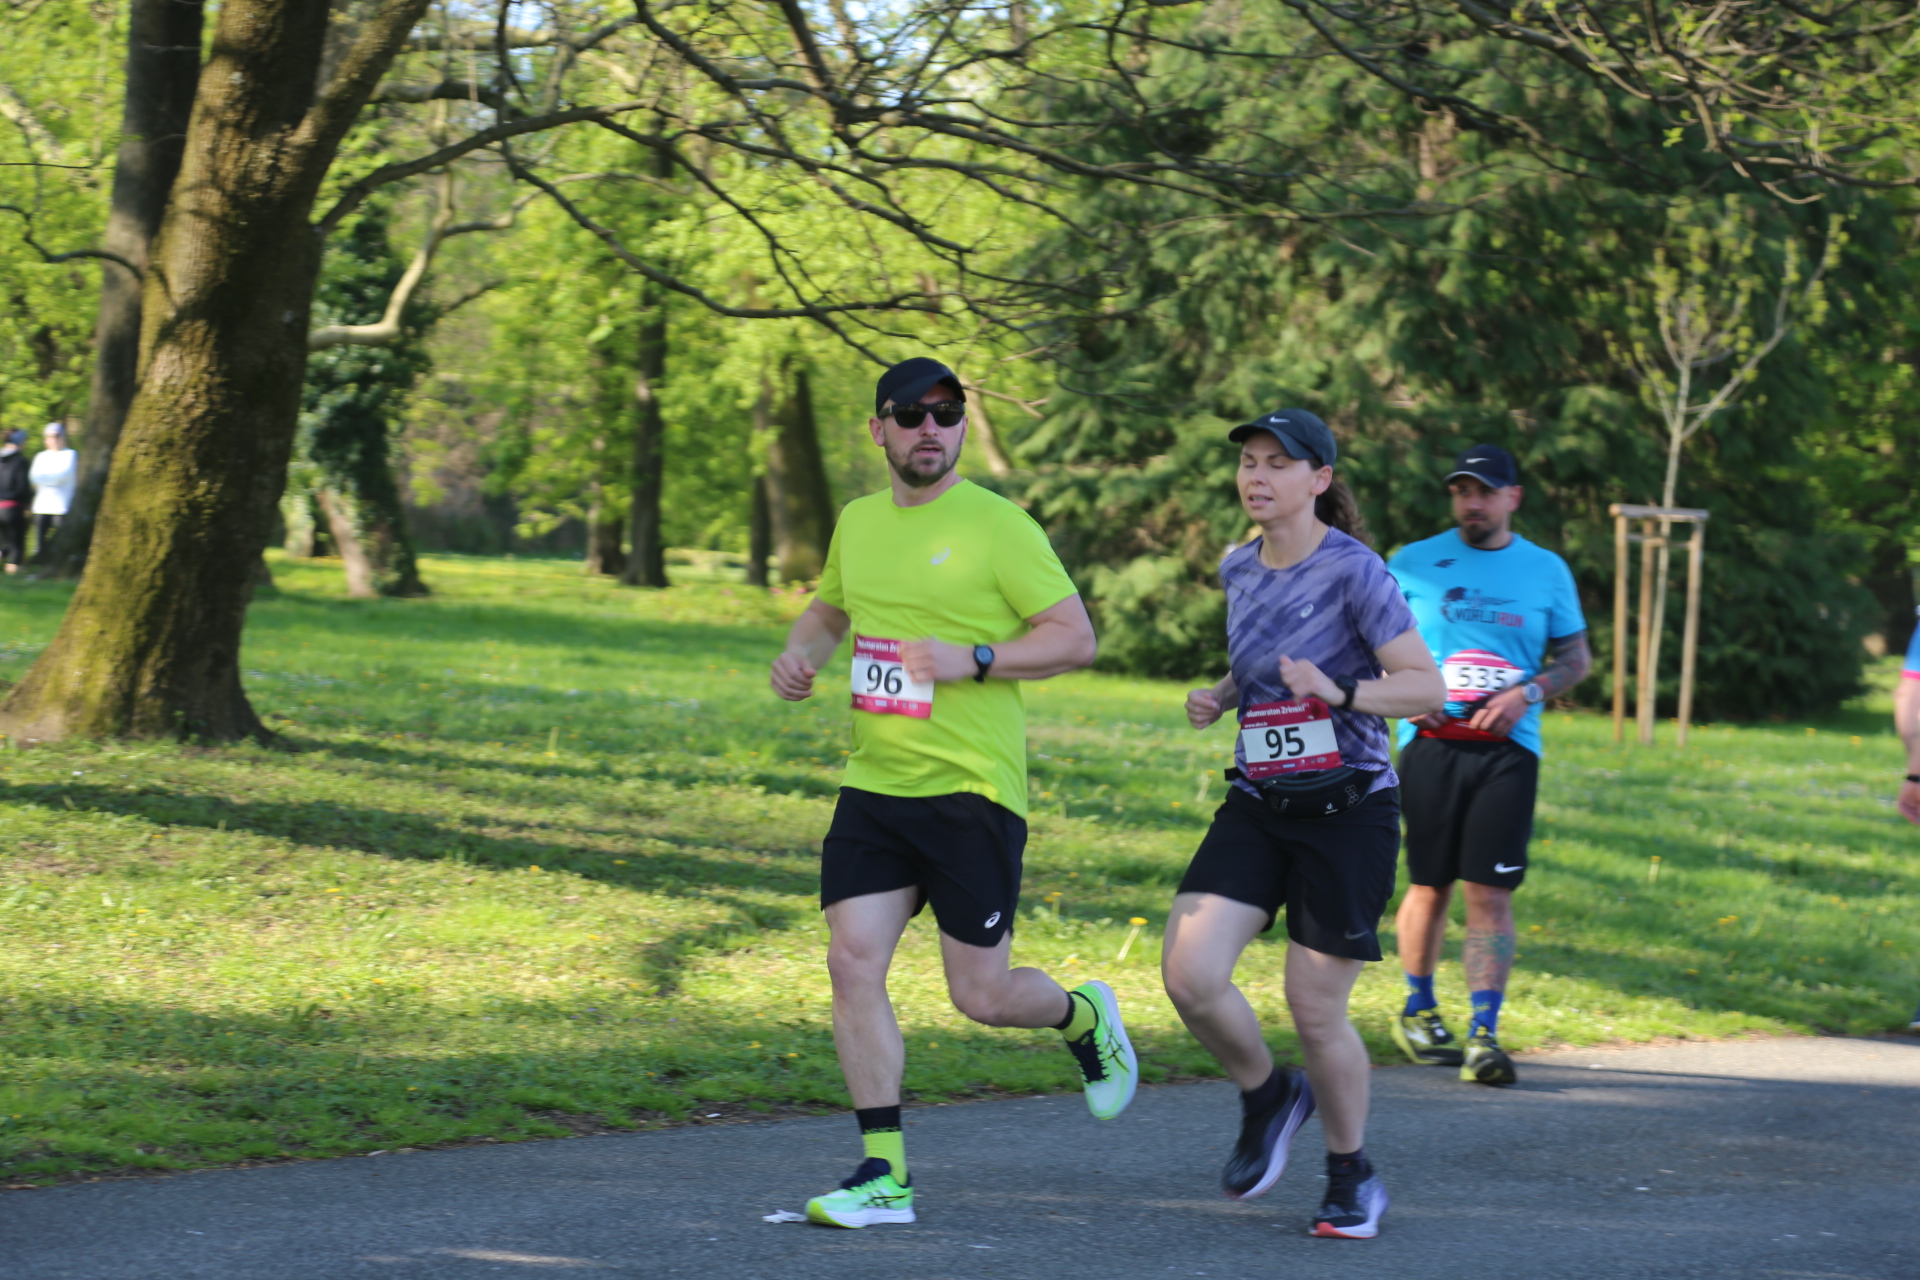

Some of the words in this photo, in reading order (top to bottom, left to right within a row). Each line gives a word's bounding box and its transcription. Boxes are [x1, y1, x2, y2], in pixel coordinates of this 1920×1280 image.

[867, 664, 902, 694] 96
[1458, 666, 1506, 691] 535
[1246, 707, 1281, 718] olumaraton
[1265, 726, 1305, 759] 95
